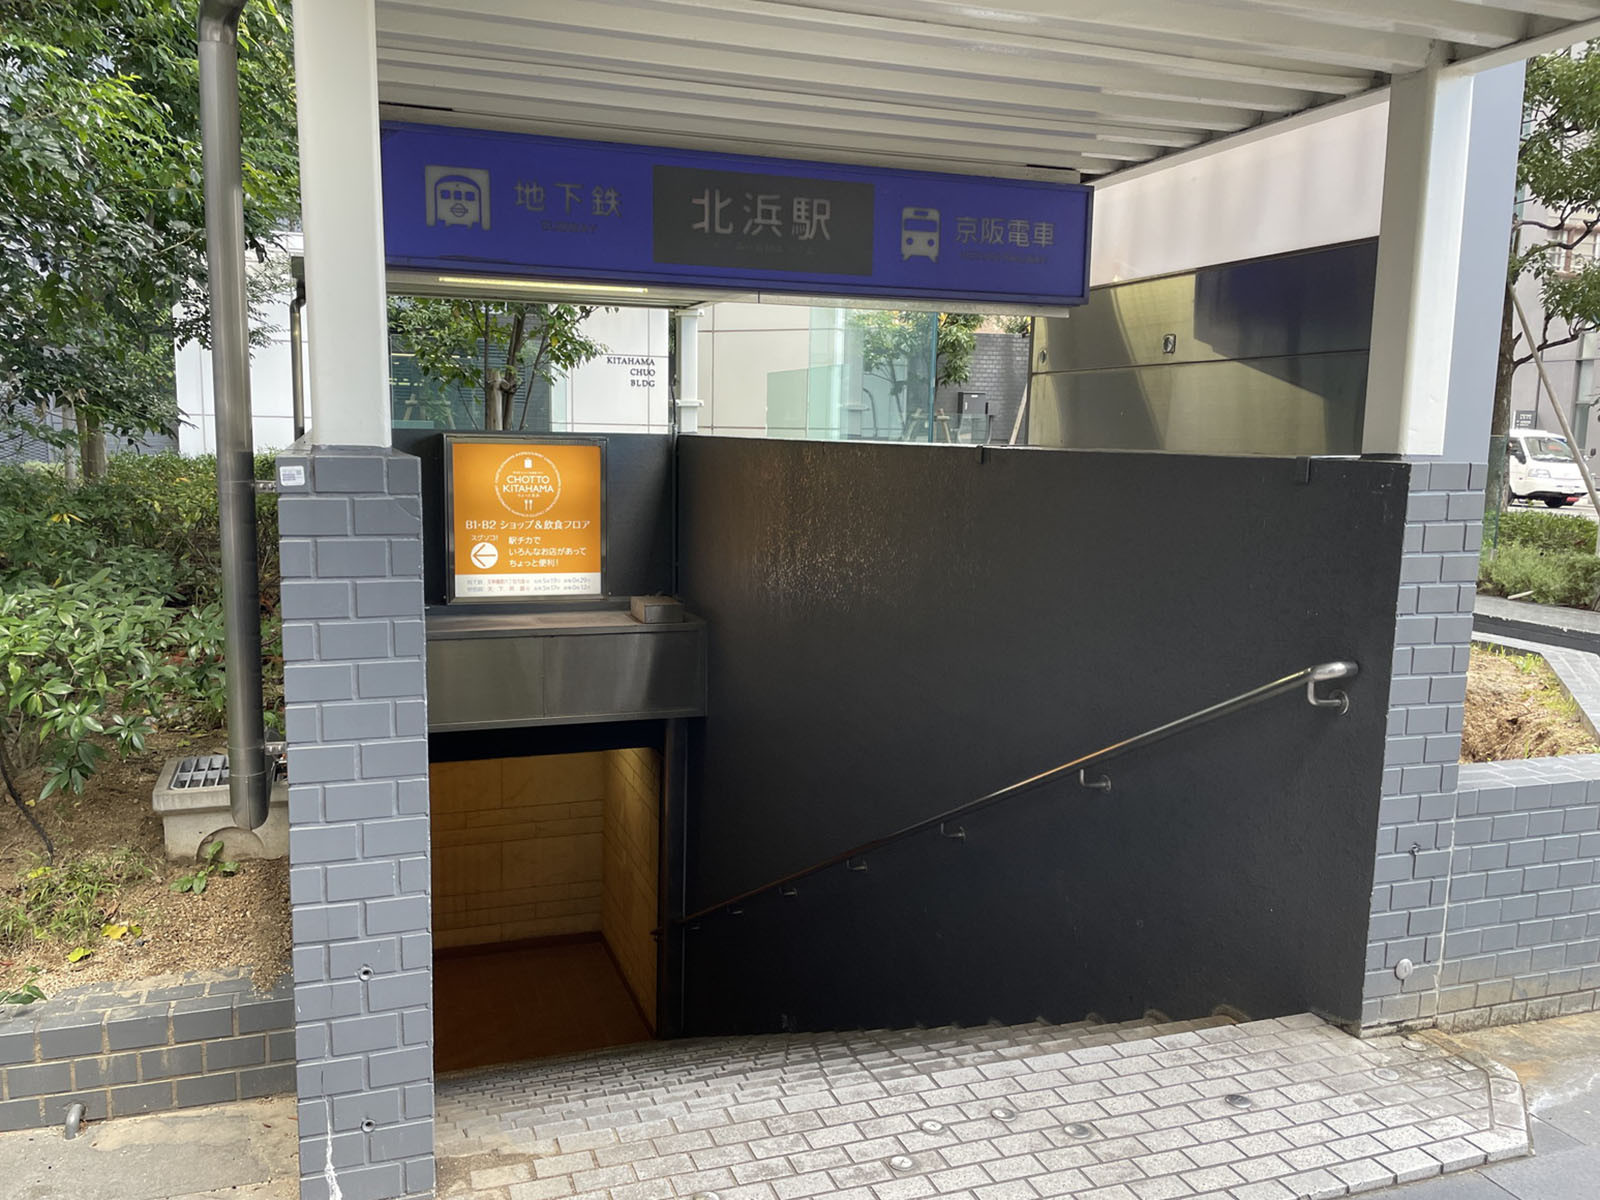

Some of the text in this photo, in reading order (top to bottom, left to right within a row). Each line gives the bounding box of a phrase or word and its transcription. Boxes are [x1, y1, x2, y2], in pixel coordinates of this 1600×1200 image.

[513, 179, 622, 218] 地下鉄
[691, 188, 831, 241] 北浜駅
[955, 216, 1056, 249] 京阪電車
[607, 356, 655, 366] KITAHAMA
[630, 368, 656, 377] CHUO
[630, 379, 655, 387] BLDG
[506, 475, 550, 484] CHOTTO
[502, 484, 555, 493] KITAHAMA
[508, 536, 542, 545] 駅チカで
[508, 547, 588, 556] いろんなお店があって
